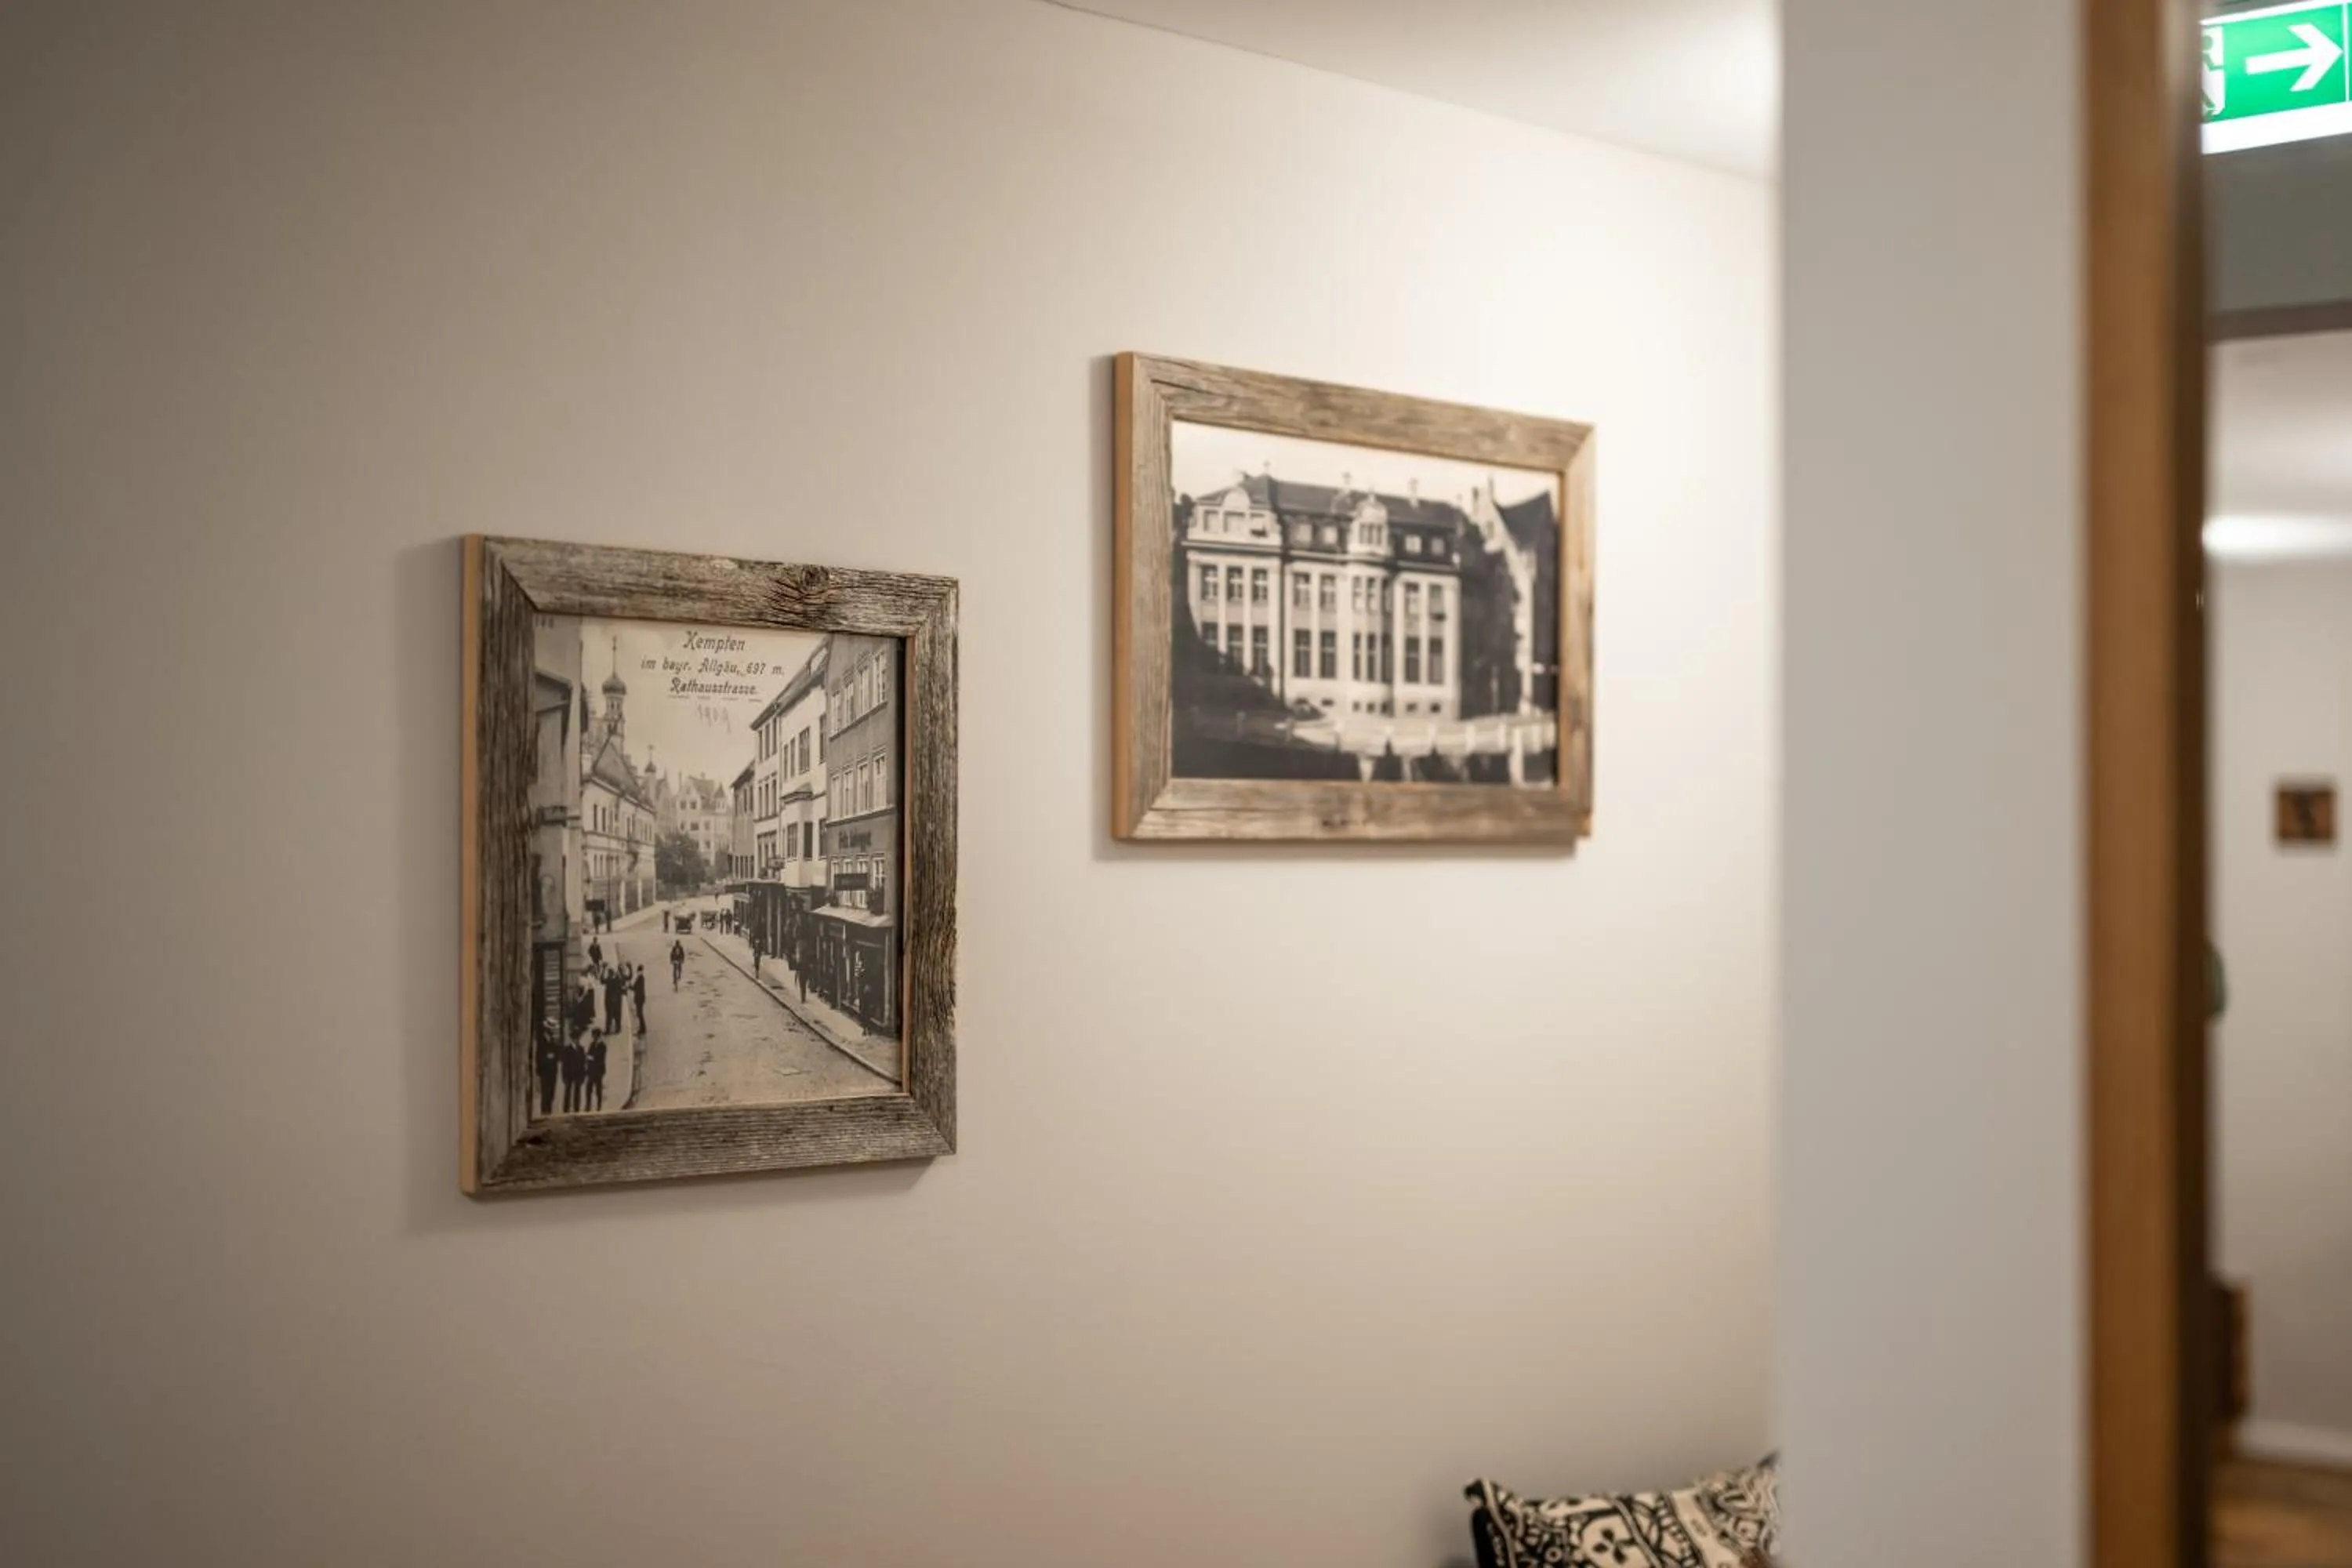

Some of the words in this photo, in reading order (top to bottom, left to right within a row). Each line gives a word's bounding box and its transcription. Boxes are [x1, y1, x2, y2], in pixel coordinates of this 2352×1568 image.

[683, 630, 746, 652] Kempten
[640, 654, 657, 670] im
[746, 662, 766, 675] 697
